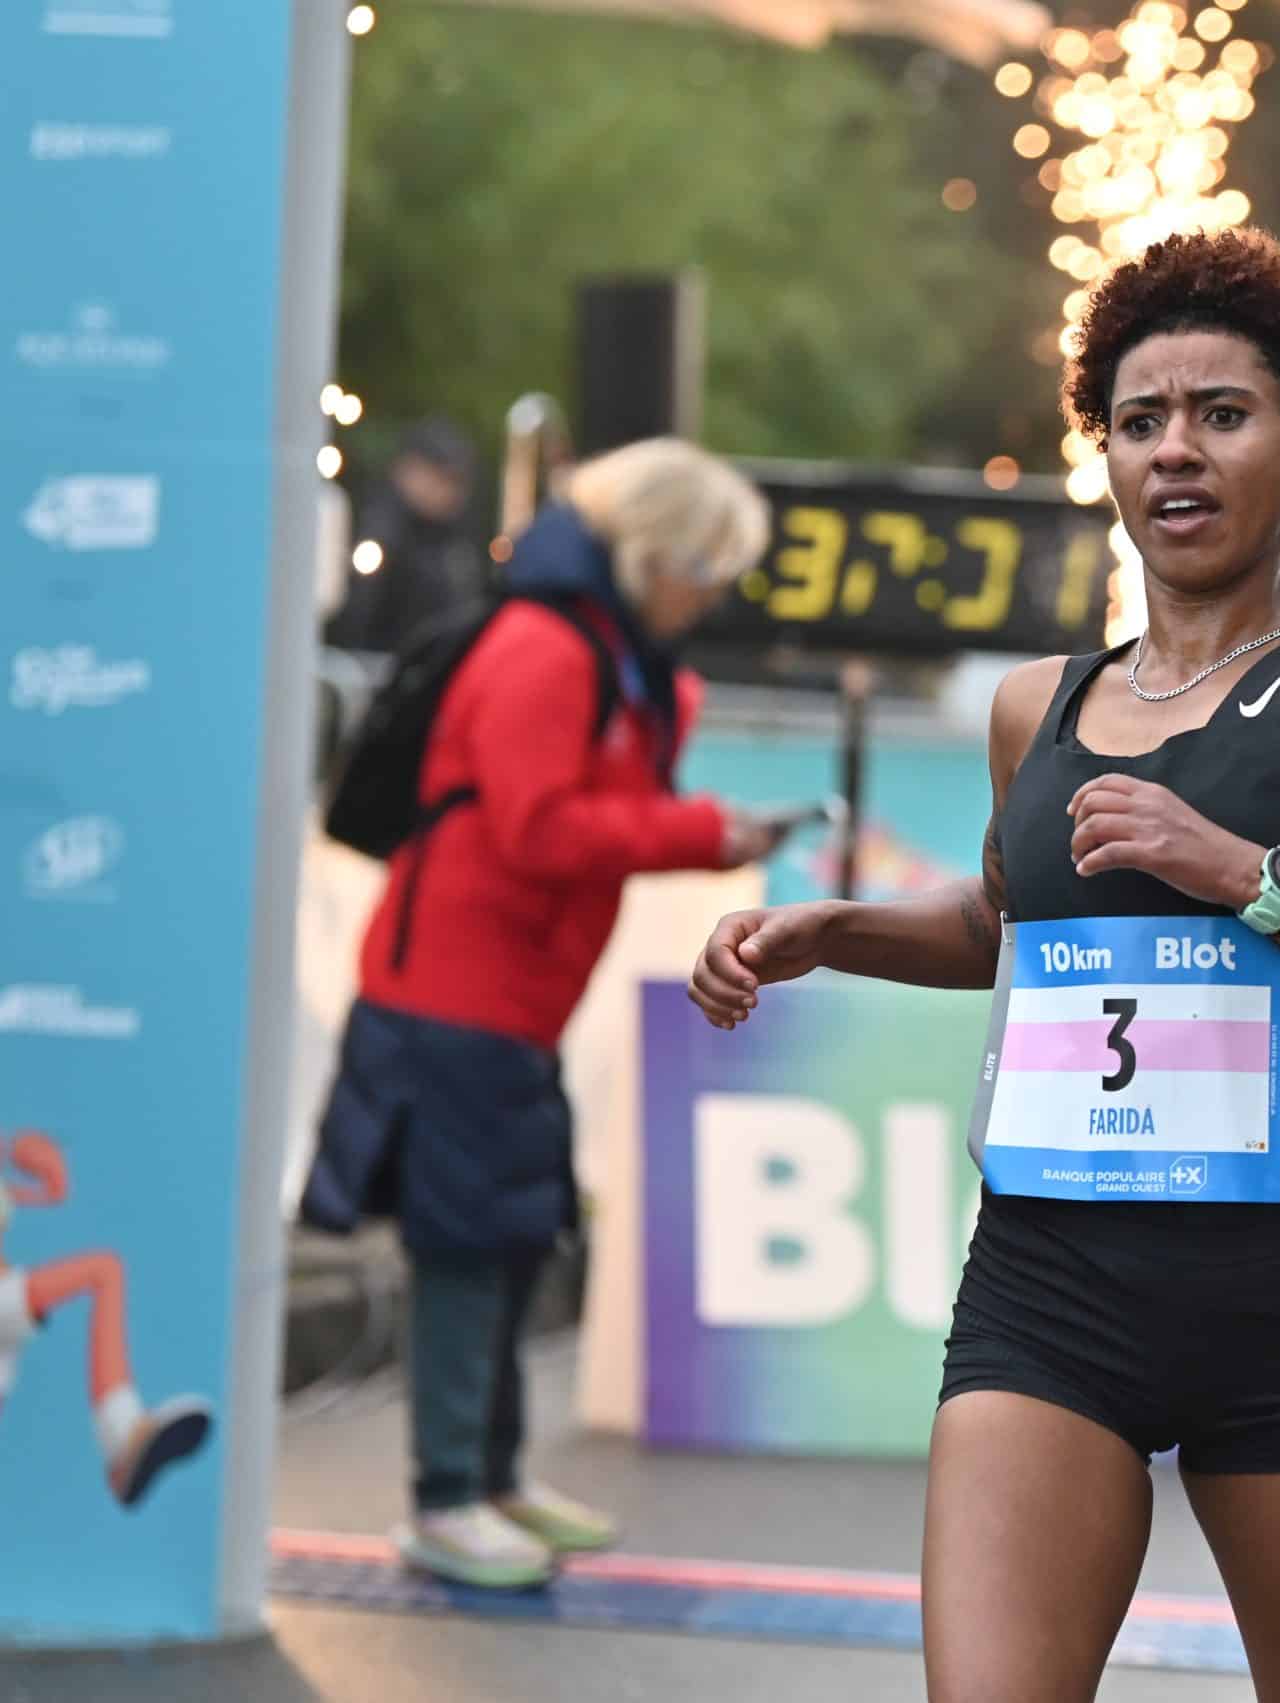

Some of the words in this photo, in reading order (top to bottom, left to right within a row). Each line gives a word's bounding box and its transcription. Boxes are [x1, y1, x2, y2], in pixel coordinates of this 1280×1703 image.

[1155, 937, 1236, 971] Blot
[1102, 998, 1137, 1092] 3
[983, 1052, 997, 1081] ELITE
[1089, 1107, 1155, 1135] FARIDA
[1042, 1168, 1094, 1183] BANQUE
[1096, 1171, 1167, 1183] POPULAIRE
[1096, 1183, 1130, 1193] GRAND
[1131, 1183, 1166, 1193] OUEST
